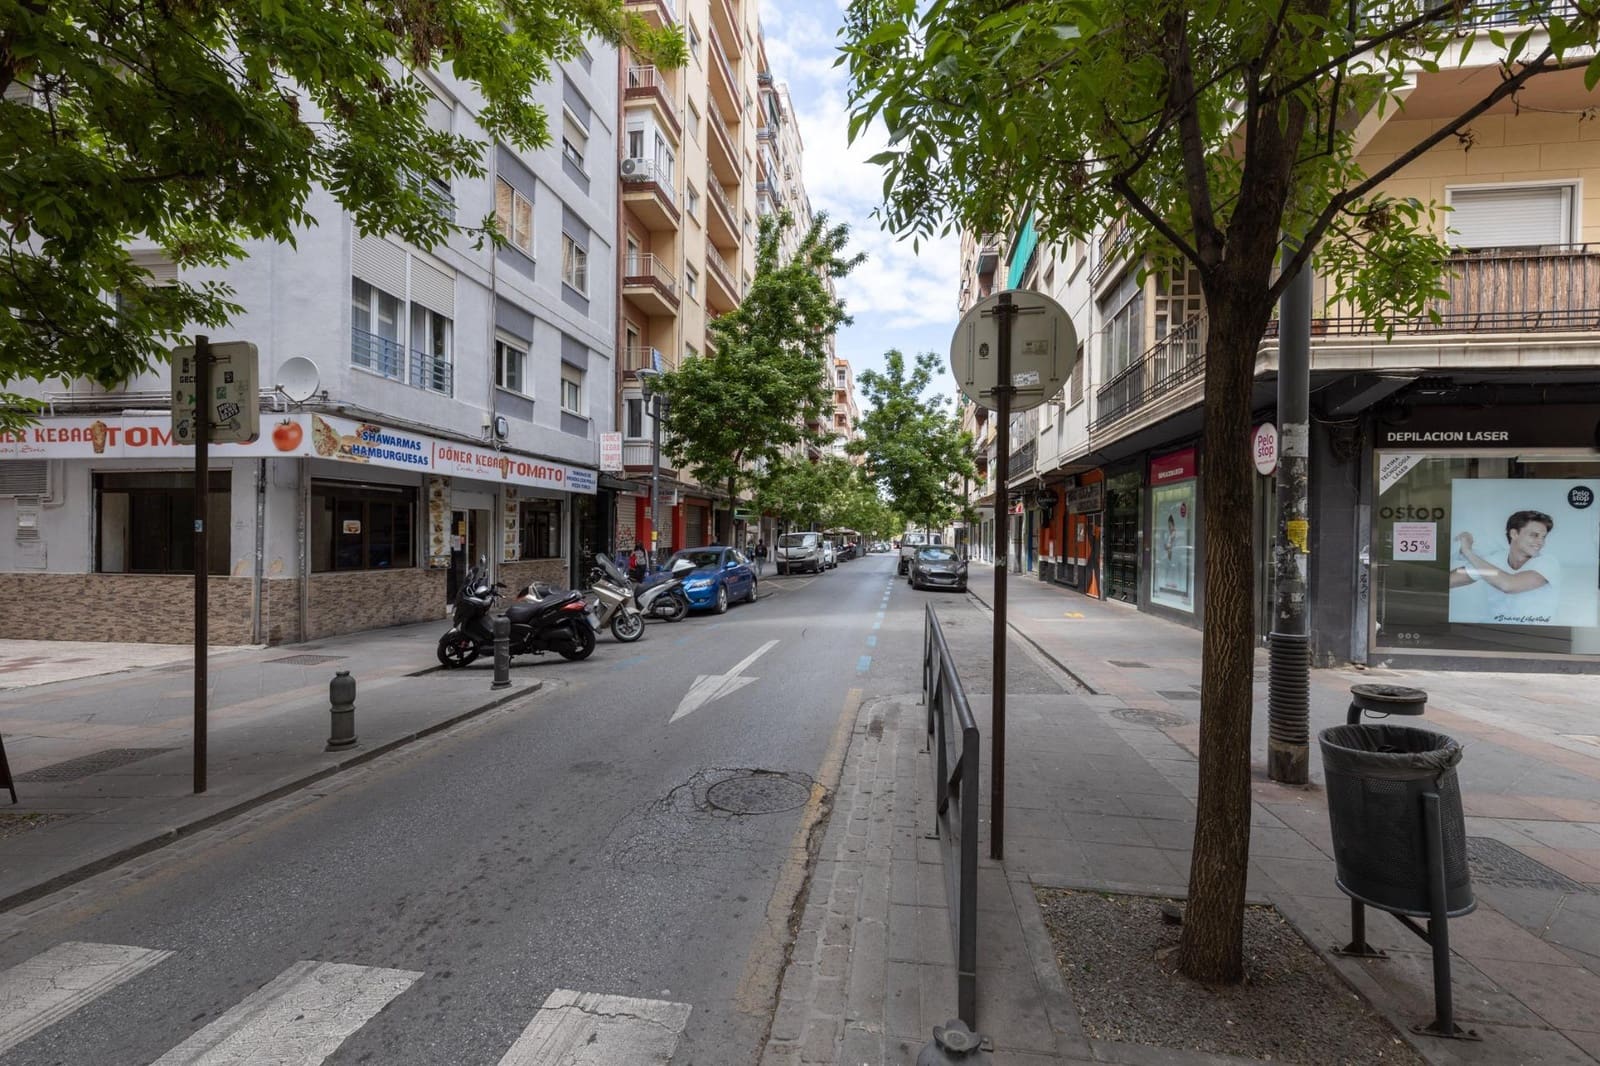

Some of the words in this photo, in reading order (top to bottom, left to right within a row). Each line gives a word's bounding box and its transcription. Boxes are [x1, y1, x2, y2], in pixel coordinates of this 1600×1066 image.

[34, 427, 93, 442] KEBAB
[362, 431, 422, 451] SHAWARMAS
[1257, 434, 1274, 447] Pelo
[352, 444, 429, 466] HAMBURGUESAS
[1257, 445, 1274, 458] stop
[439, 446, 473, 464] DÖNER
[475, 454, 504, 470] KEBAB
[507, 460, 563, 482] TOMATO
[1400, 540, 1431, 552] 35%
